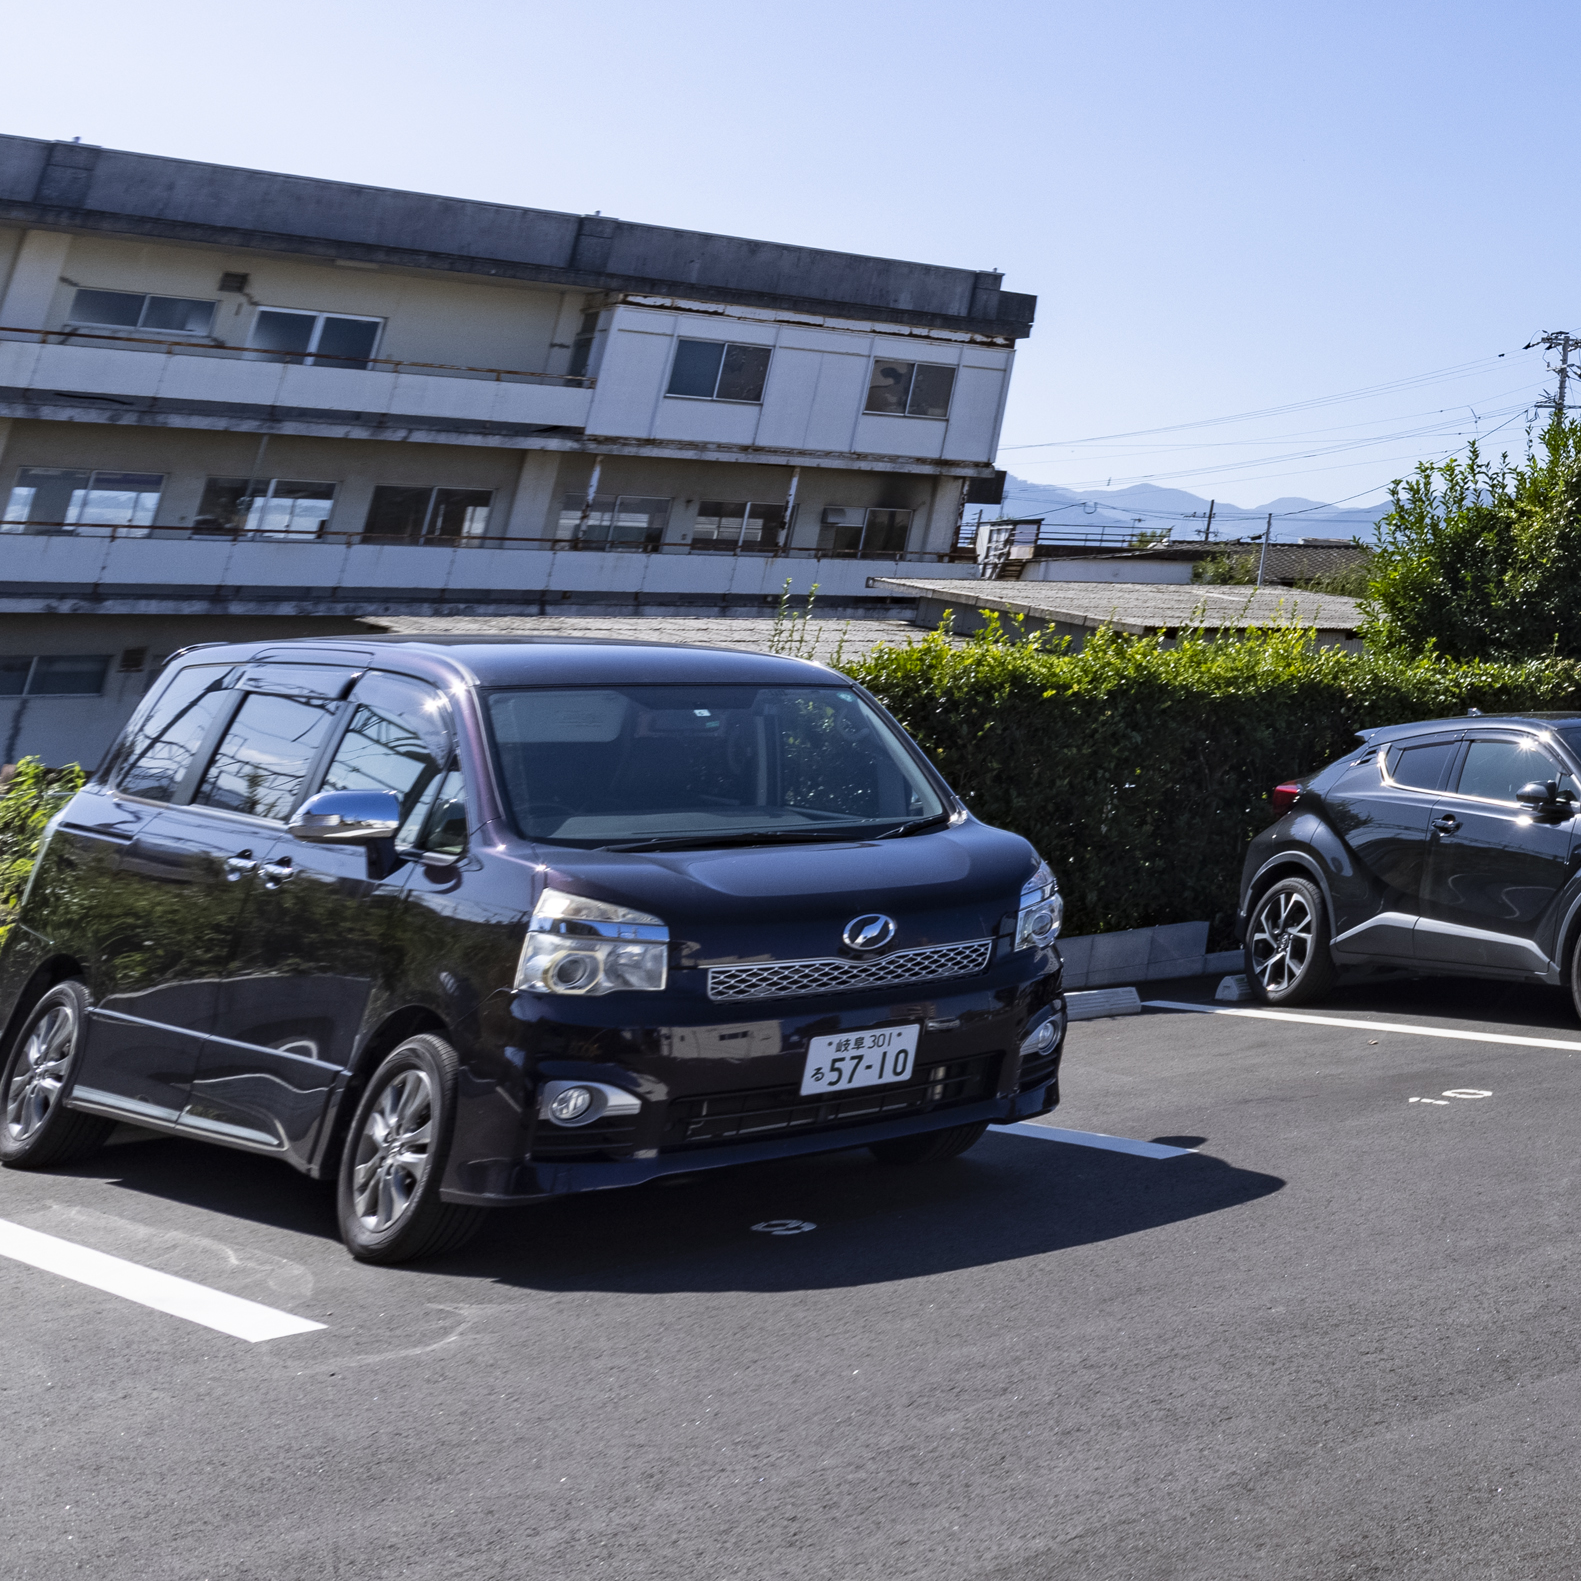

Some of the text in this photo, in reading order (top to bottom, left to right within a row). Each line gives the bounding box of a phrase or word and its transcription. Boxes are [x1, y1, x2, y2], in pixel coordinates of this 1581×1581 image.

[835, 1032, 893, 1053] 岐阜301
[810, 1048, 909, 1086] る 57-10
